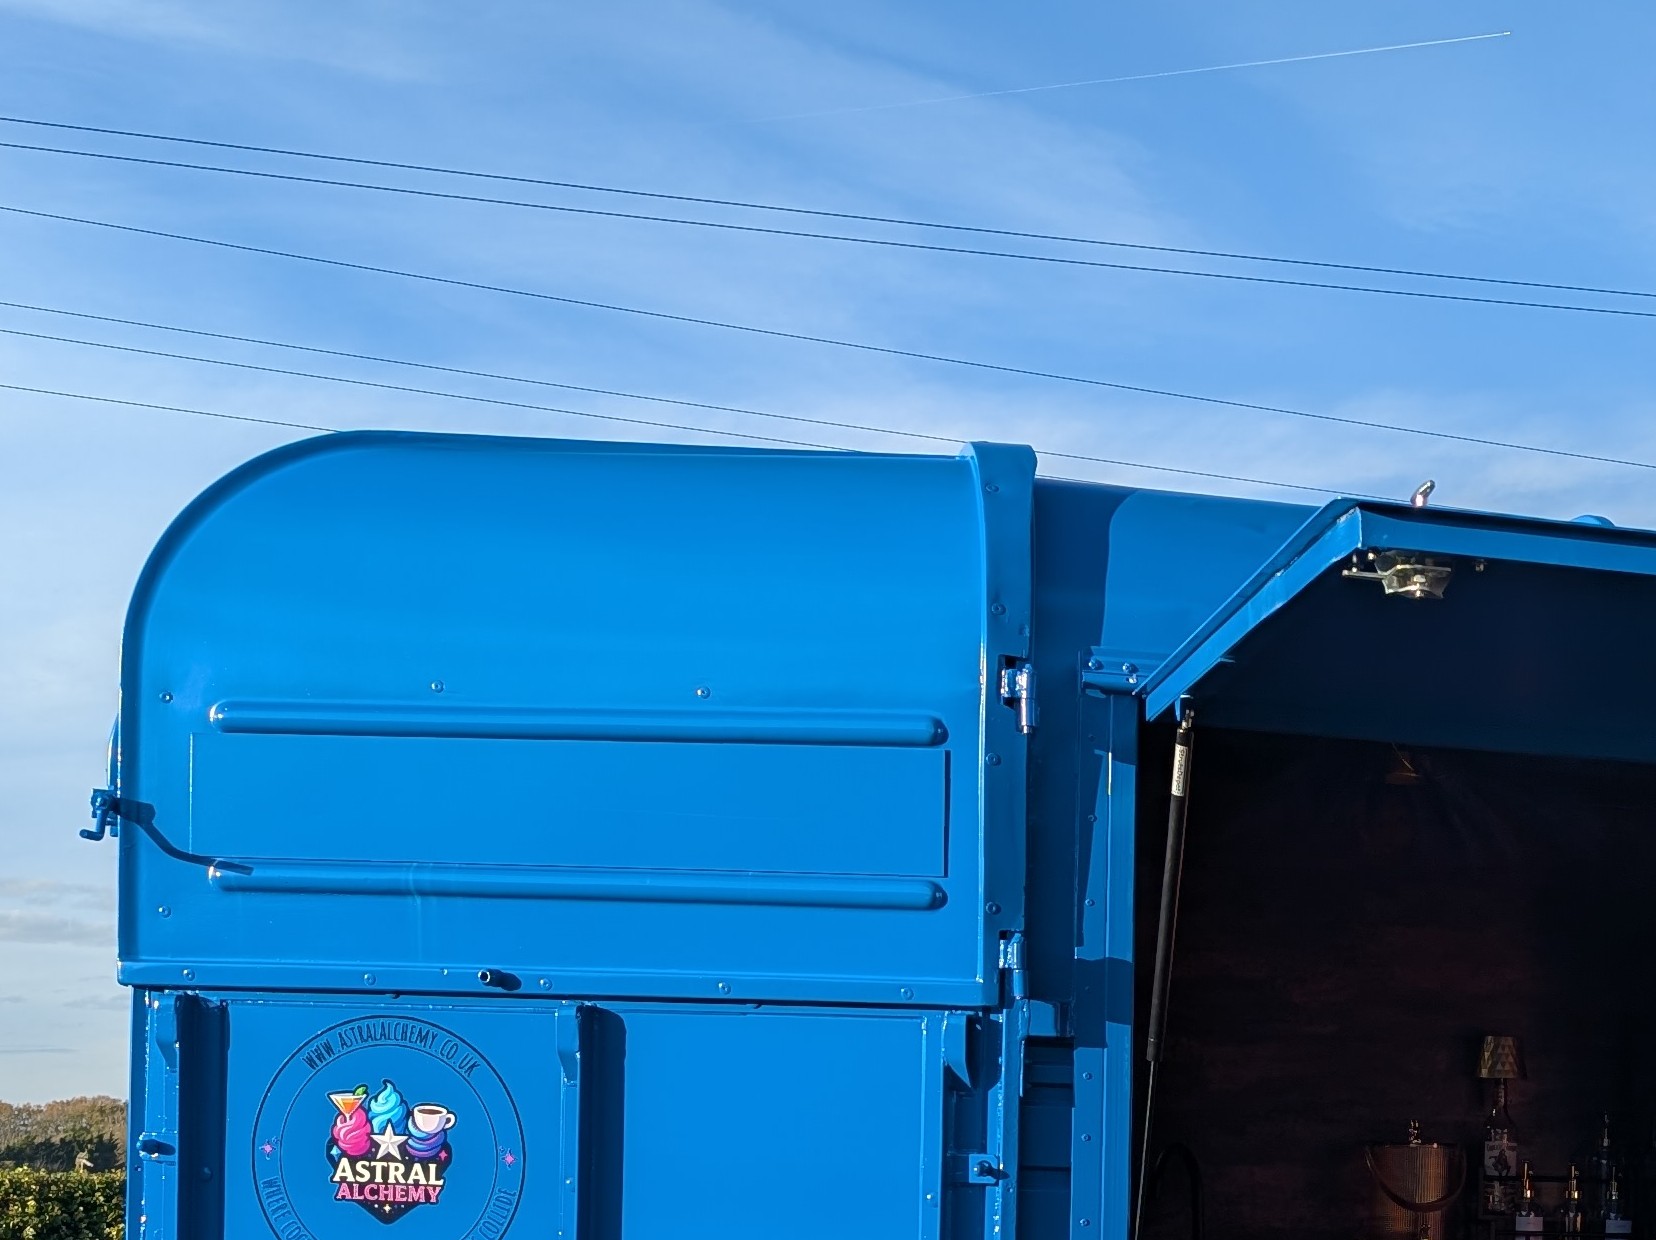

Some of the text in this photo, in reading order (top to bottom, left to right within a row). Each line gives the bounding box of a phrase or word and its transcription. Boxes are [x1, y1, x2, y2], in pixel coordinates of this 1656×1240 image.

[333, 1157, 444, 1185] ASTRAL
[336, 1183, 442, 1203] ALCHEMY
[260, 1176, 292, 1222] WHERE
[478, 1187, 517, 1240] COLLIDE
